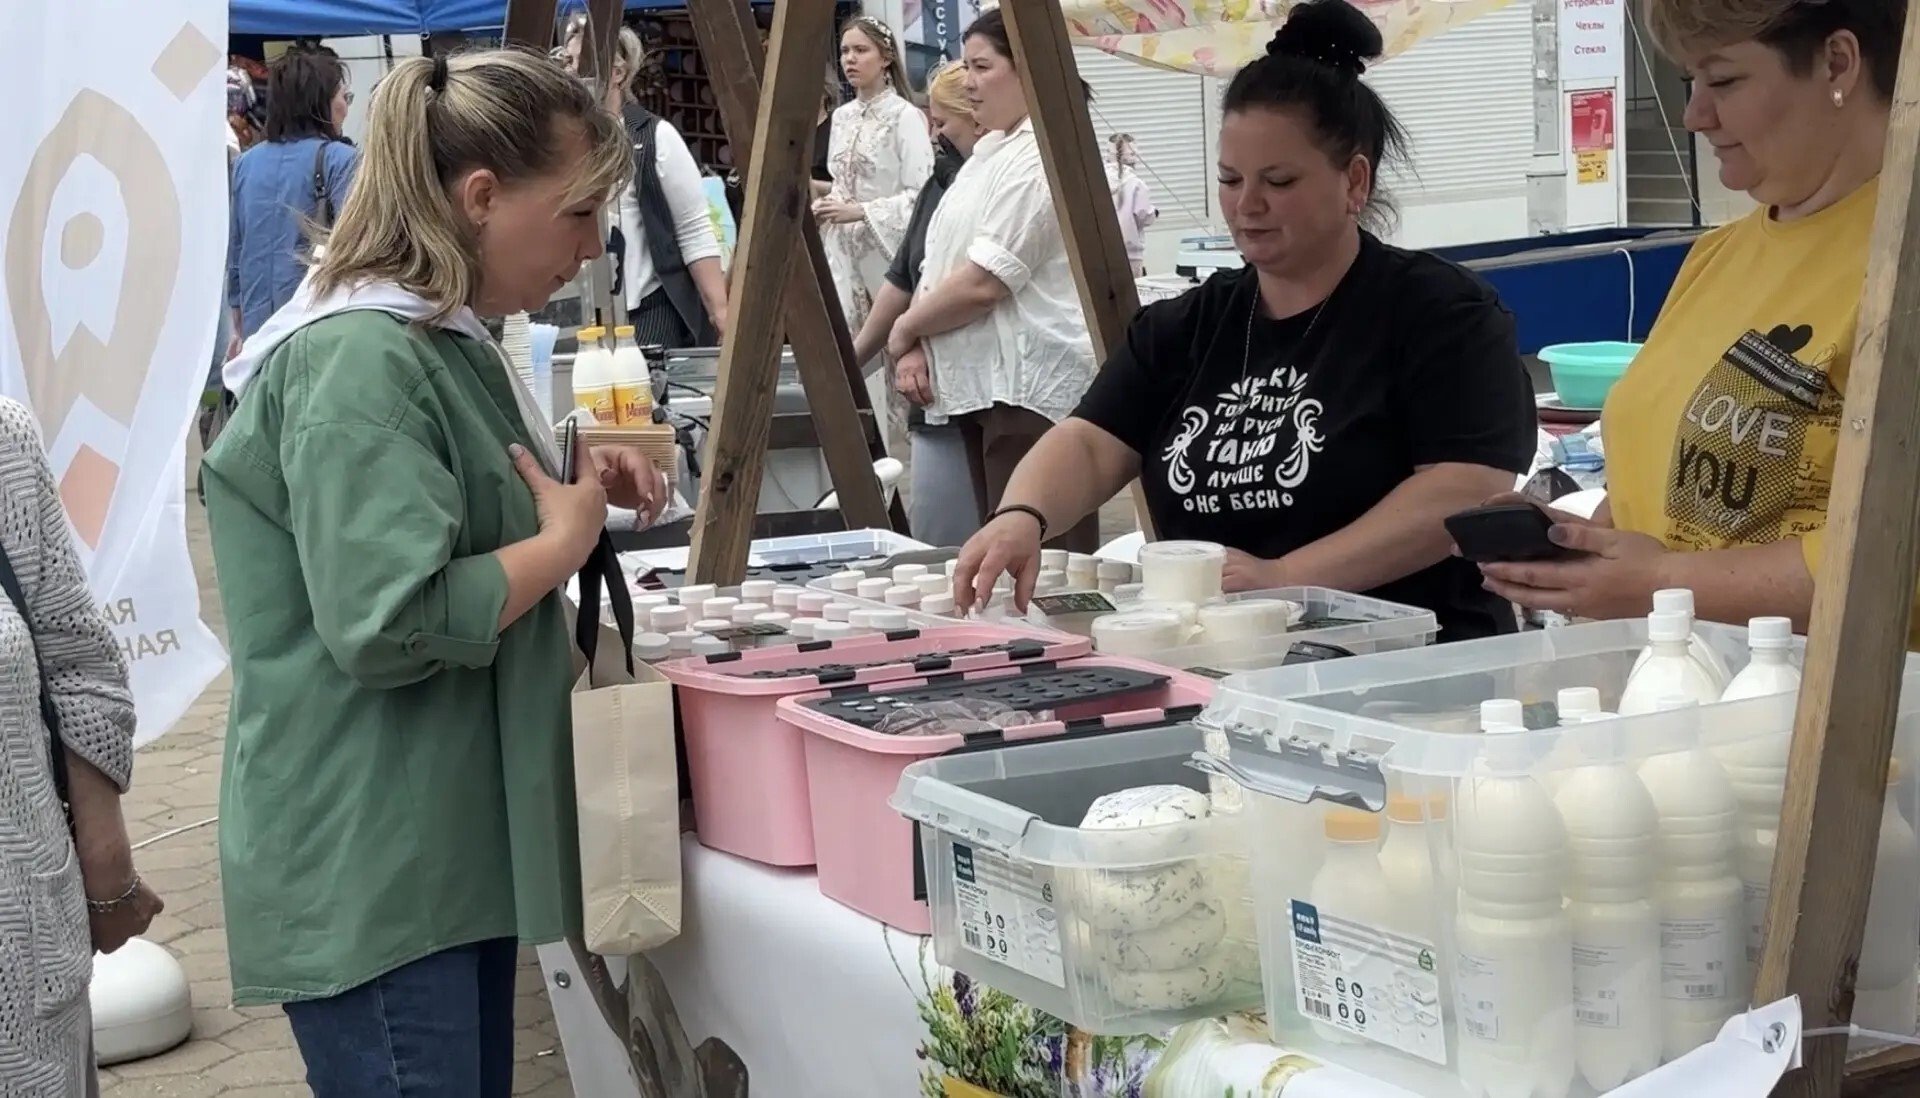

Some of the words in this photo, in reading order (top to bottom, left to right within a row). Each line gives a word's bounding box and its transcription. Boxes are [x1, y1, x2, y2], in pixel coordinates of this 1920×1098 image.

[935, 0, 949, 66] ССУА
[1575, 21, 1605, 30] Чехлы
[1574, 45, 1606, 54] Стекла
[1243, 414, 1287, 436] РУСИ
[1685, 382, 1794, 457] LOVE
[1206, 433, 1277, 465] ТАНЮ
[1207, 464, 1264, 489] ЛУЧШЕ
[1676, 438, 1758, 510] YOU
[102, 597, 137, 625] АЯ
[119, 629, 181, 661] НАЯ
